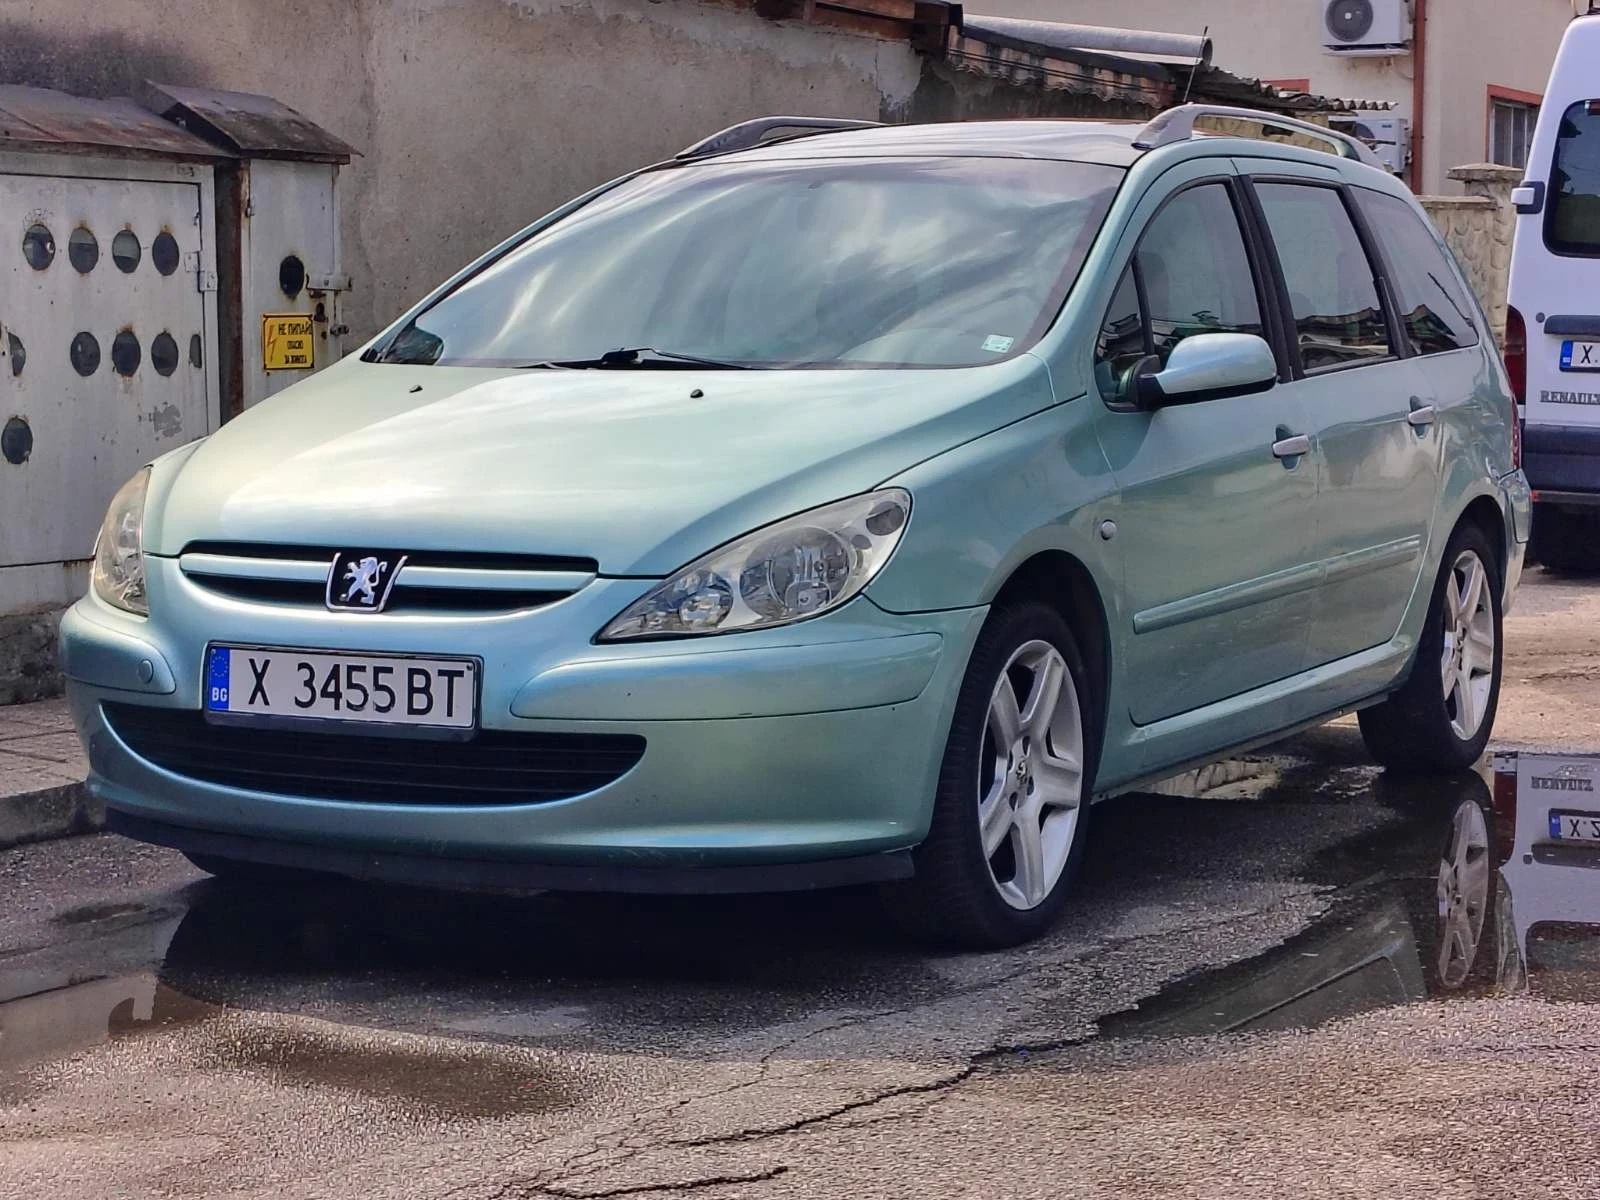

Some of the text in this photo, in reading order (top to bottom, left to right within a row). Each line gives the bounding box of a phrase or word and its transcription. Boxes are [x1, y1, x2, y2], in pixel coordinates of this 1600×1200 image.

[212, 687, 228, 702] BG
[248, 658, 465, 717] X 3455 BT
